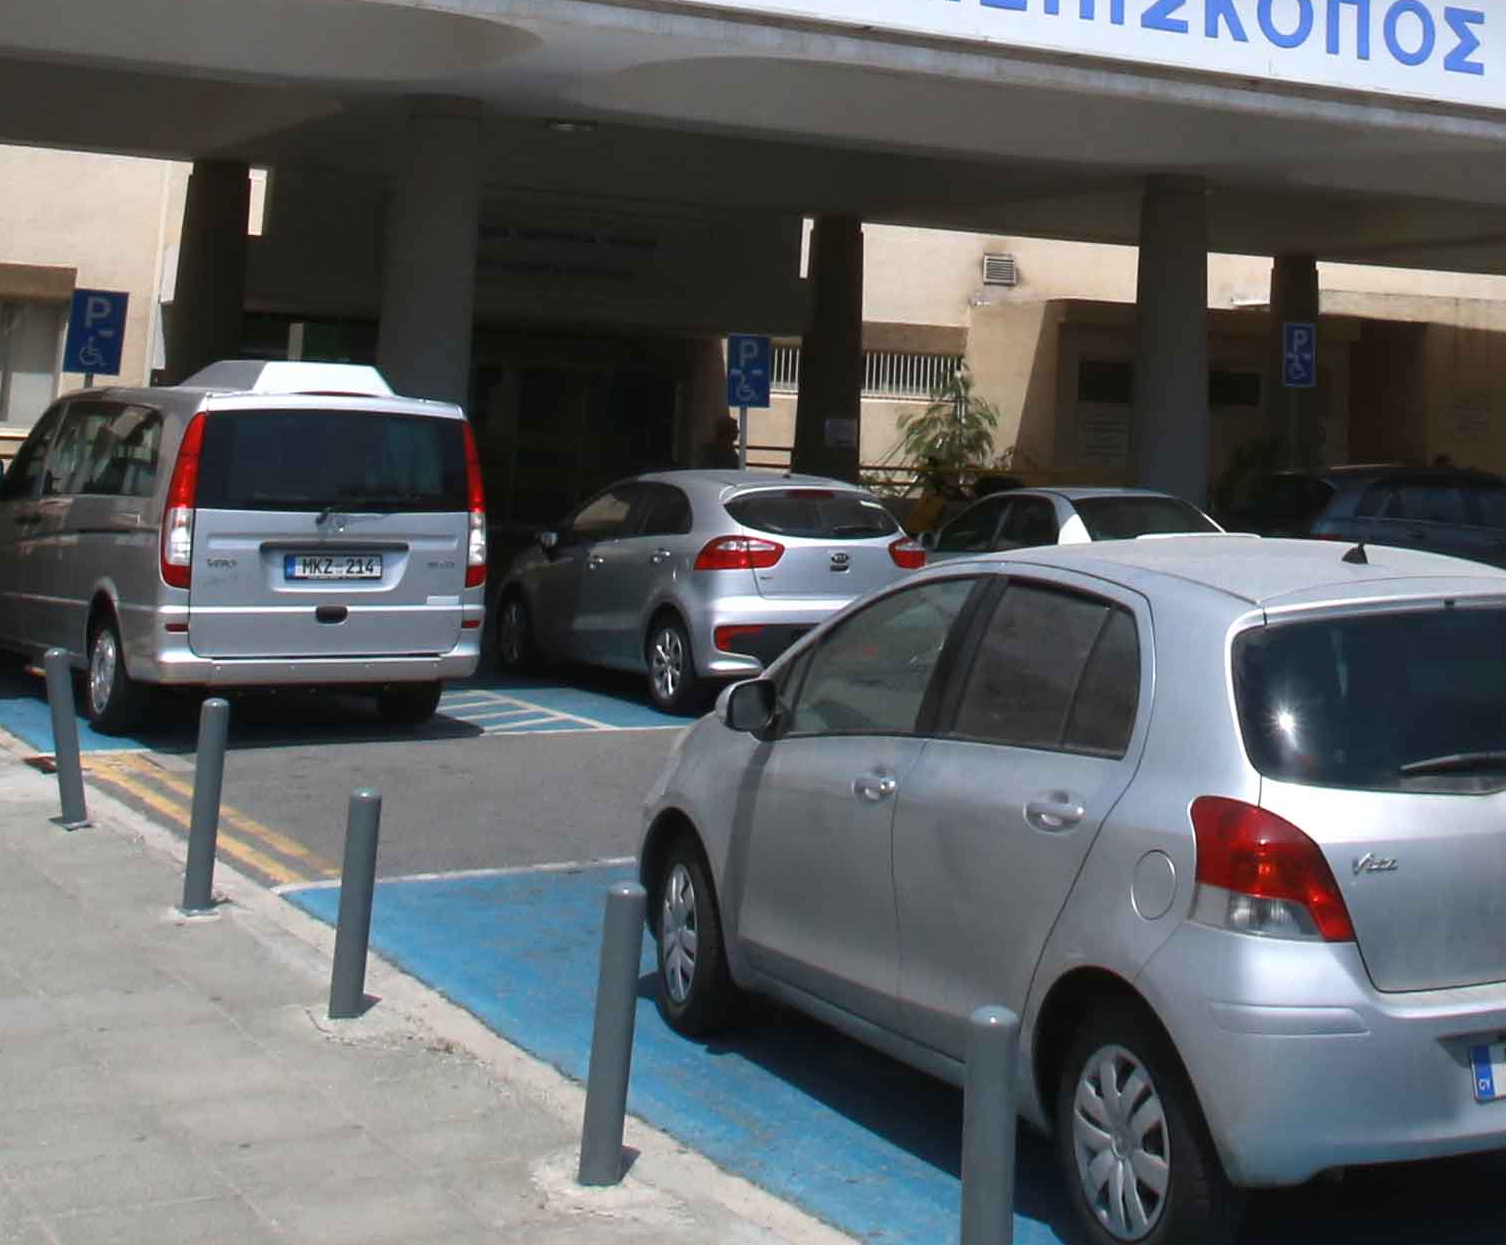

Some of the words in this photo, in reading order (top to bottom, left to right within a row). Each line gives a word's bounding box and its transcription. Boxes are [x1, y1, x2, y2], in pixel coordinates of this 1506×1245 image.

[84, 296, 112, 329] P
[739, 339, 759, 368] P
[1293, 329, 1309, 354] P
[301, 558, 334, 575] MKZ
[345, 558, 374, 574] 214
